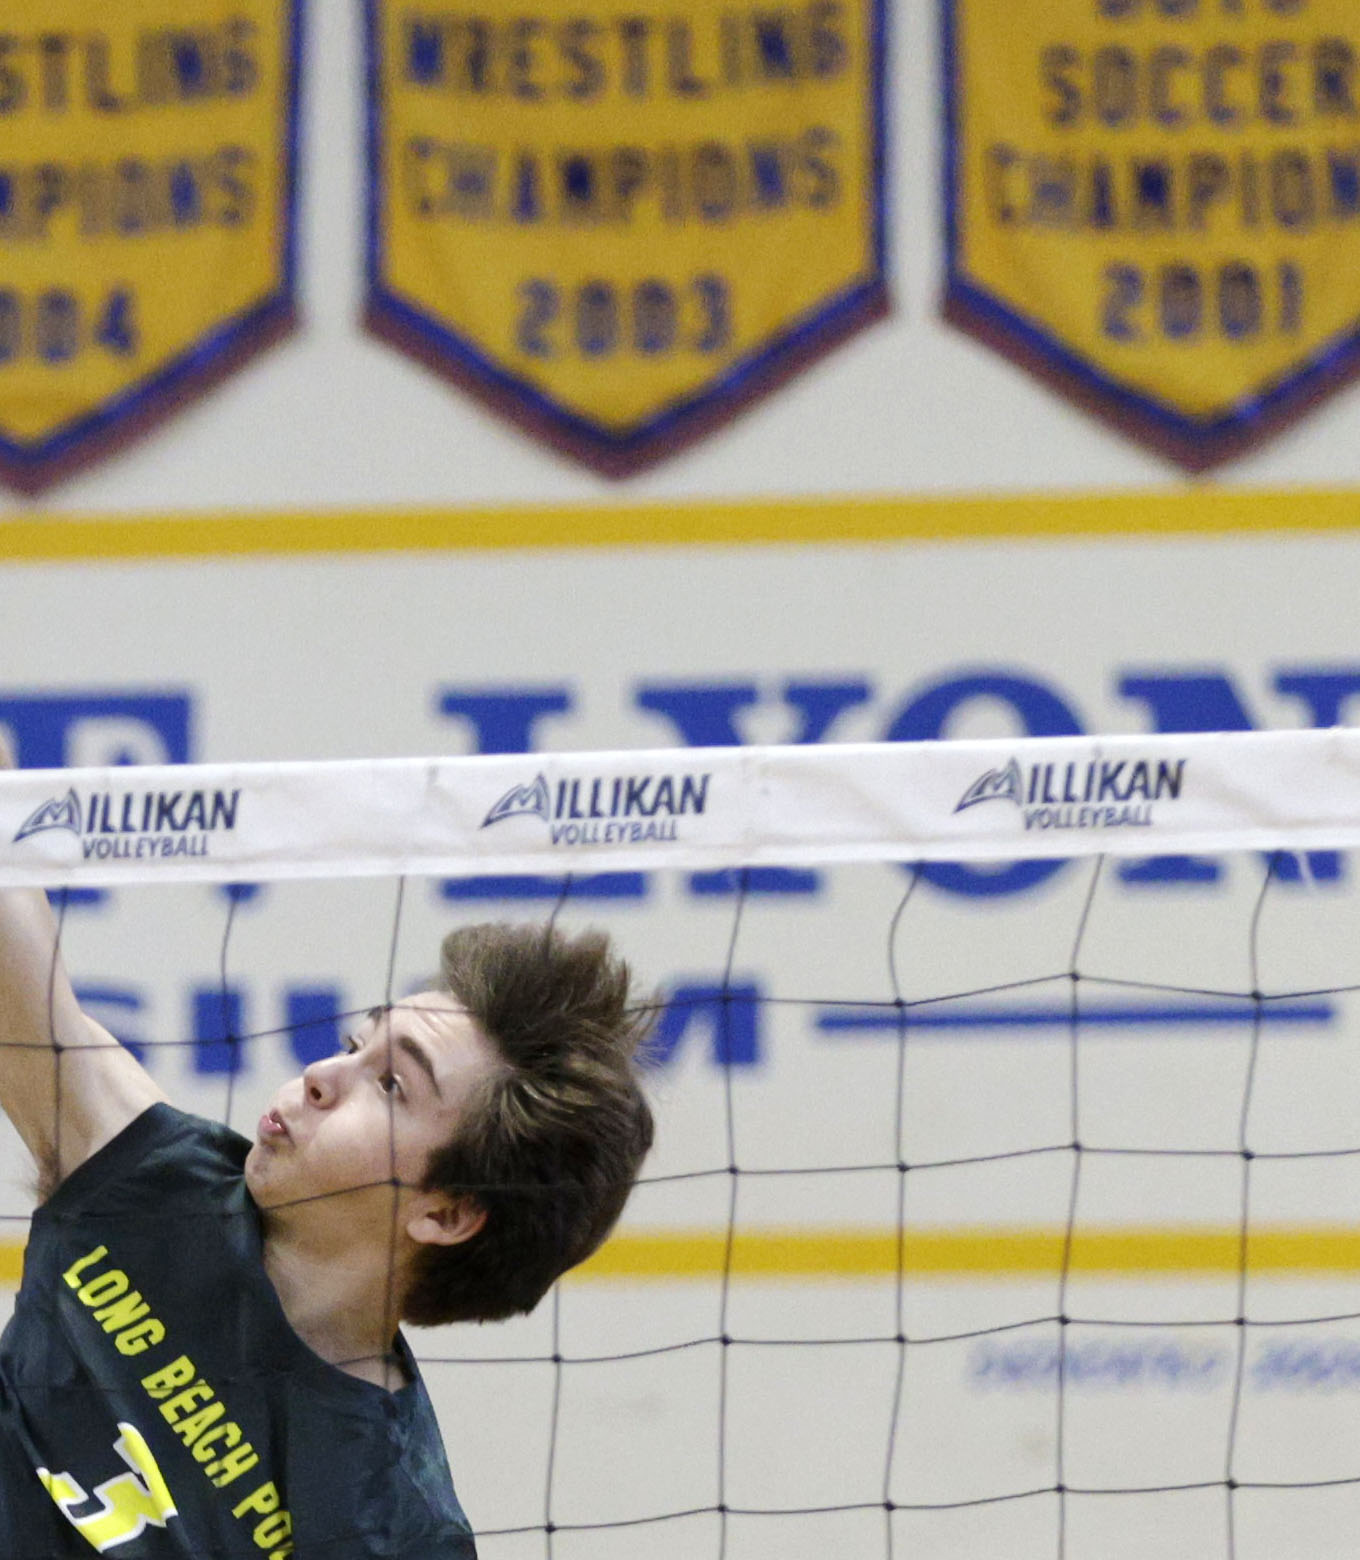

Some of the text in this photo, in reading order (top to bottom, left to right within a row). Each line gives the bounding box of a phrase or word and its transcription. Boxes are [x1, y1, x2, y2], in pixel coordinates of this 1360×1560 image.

[404, 0, 846, 100] WRESTLING
[1038, 38, 1360, 130] SOCCER
[402, 128, 838, 226] CHAMPIONS
[516, 274, 734, 358] 2003
[1098, 260, 1306, 346] 2001
[83, 833, 209, 859] VOLLEYBALL
[549, 819, 679, 845] VOLLEYBALL
[1022, 803, 1153, 829] VOLLEYBALL
[61, 1244, 167, 1358] LONG
[139, 1354, 260, 1489] BEACH
[35, 1421, 180, 1555] 3
